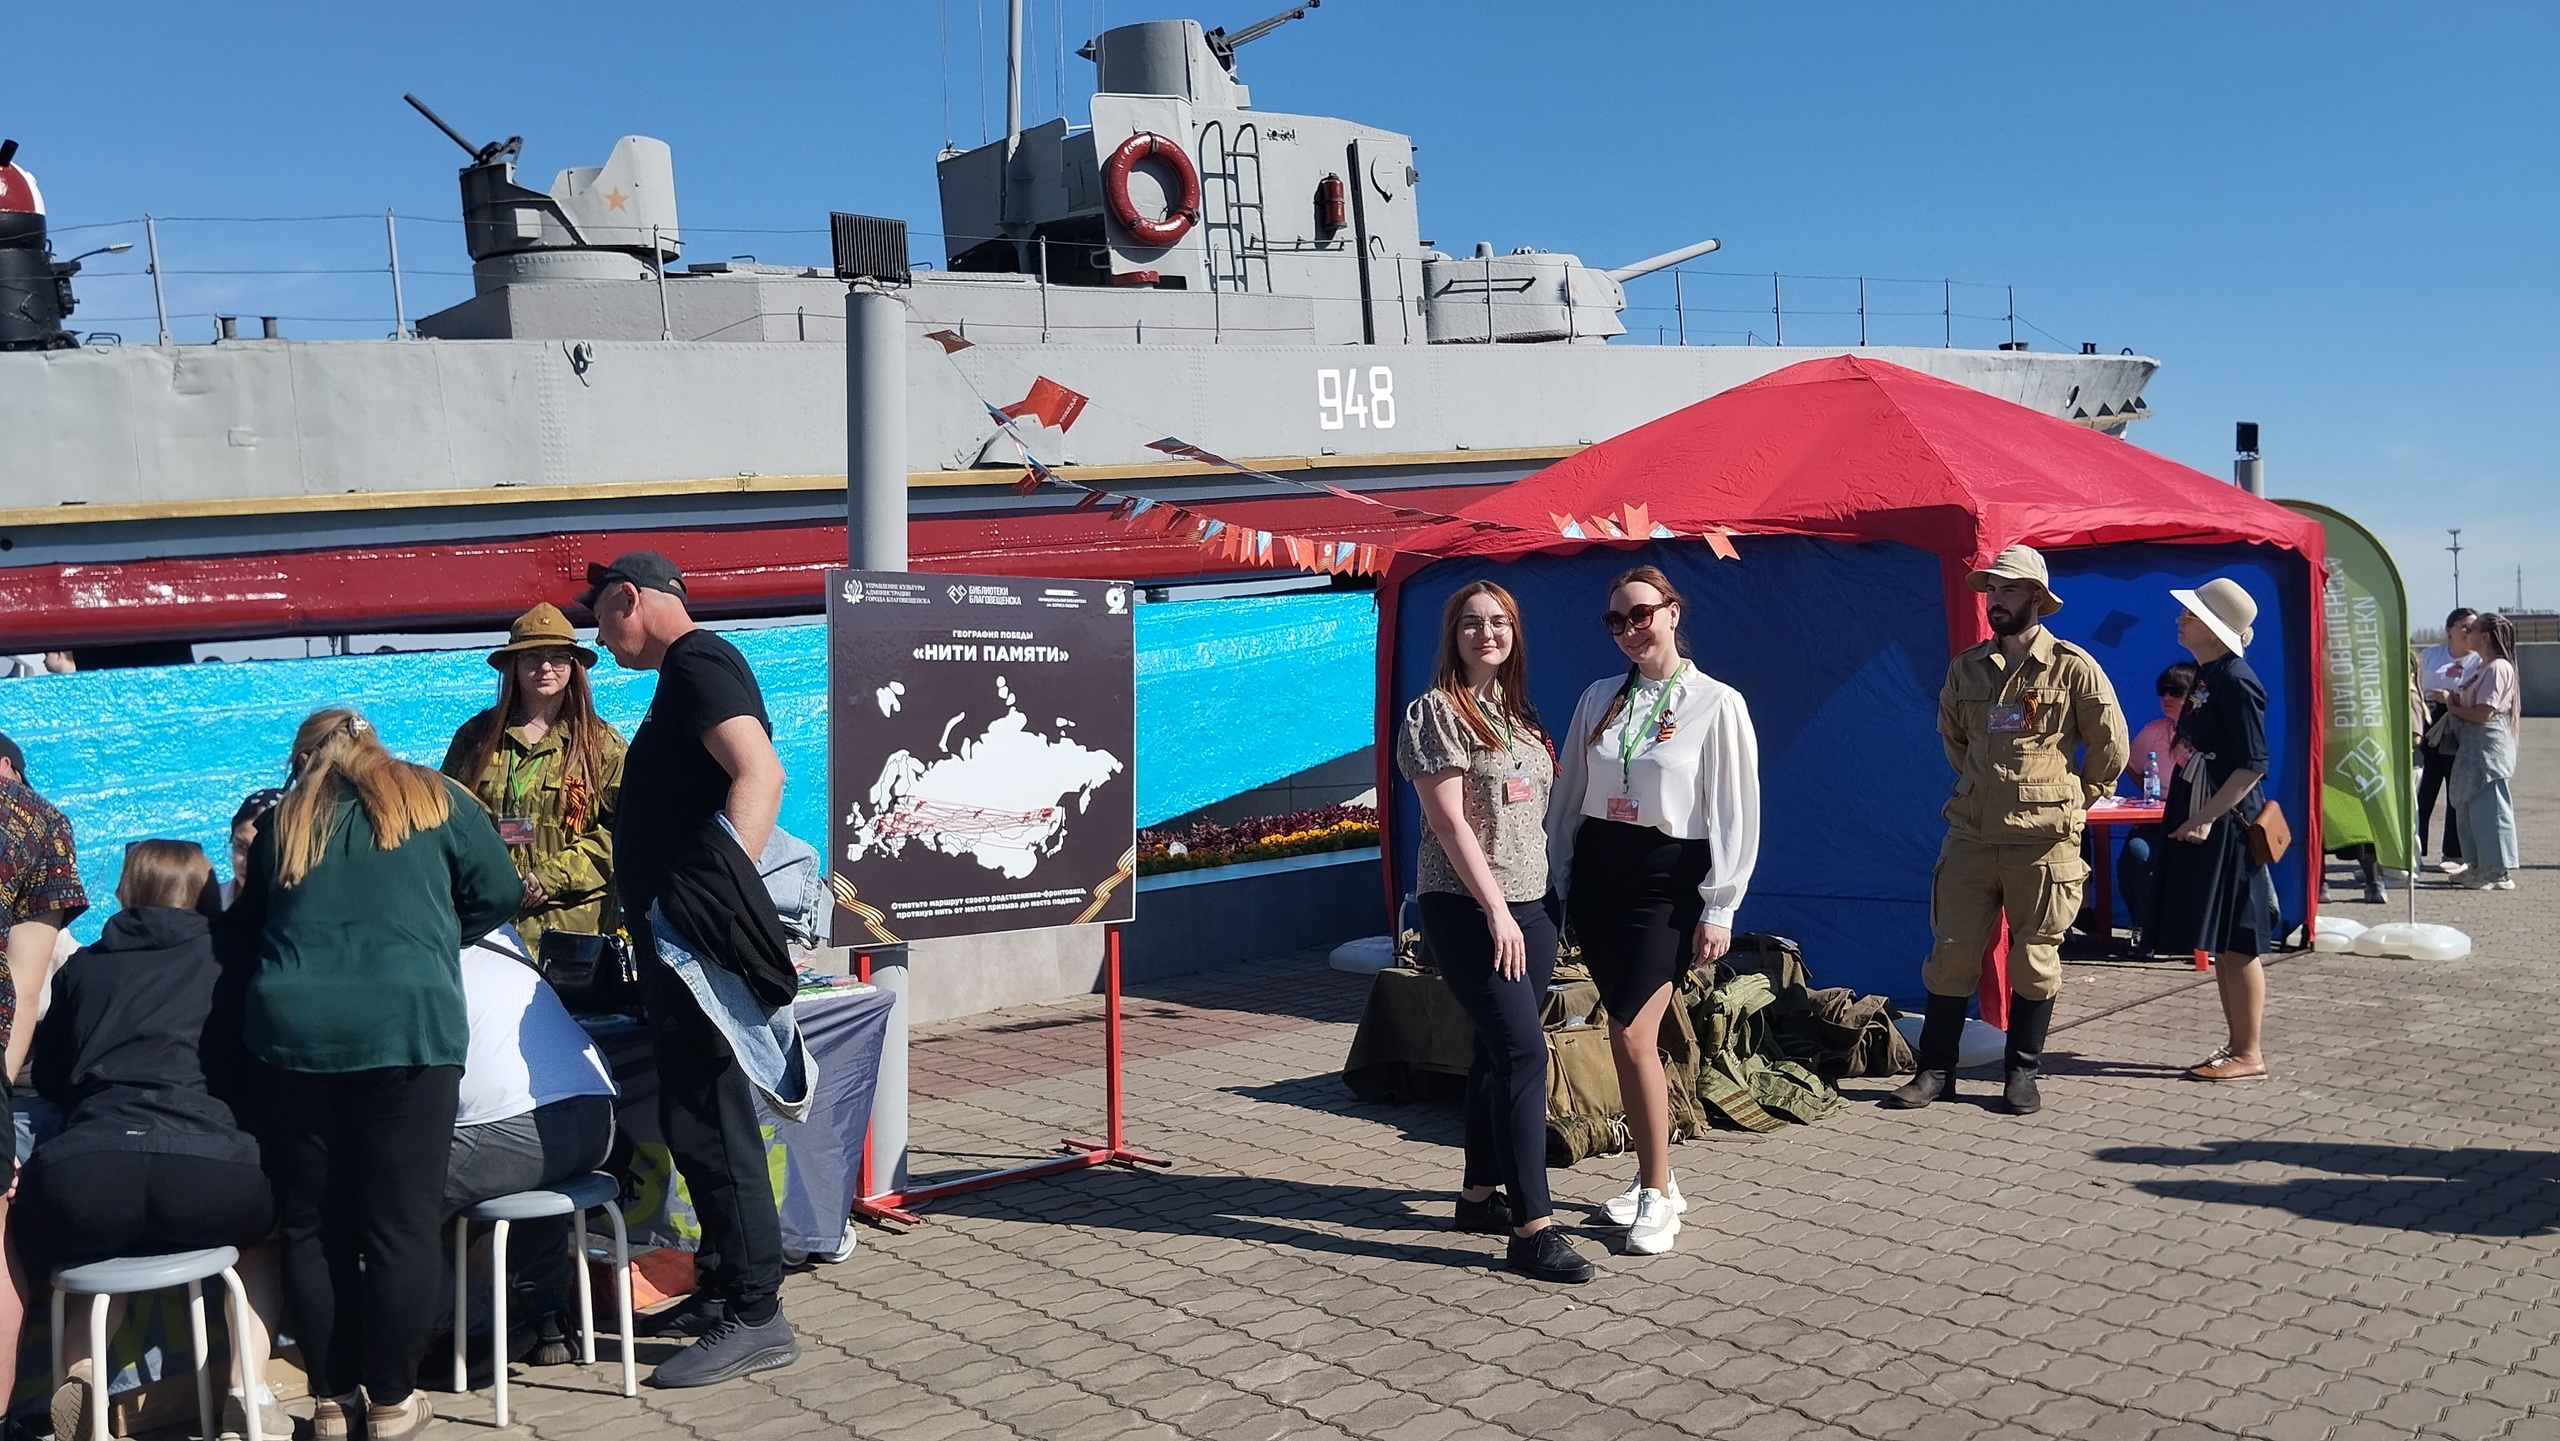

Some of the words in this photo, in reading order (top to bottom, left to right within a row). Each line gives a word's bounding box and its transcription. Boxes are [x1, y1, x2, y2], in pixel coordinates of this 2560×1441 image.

[1317, 366, 1396, 430] 948
[969, 585, 1009, 596] БИБЛИОТЕКИ
[887, 596, 931, 604] БЛАГОВЕЩЕНСКА
[969, 595, 1022, 605] БЛАГОВЕЩЕНСКА
[952, 630, 999, 639] ГЕОГРАФИЯ
[1001, 631, 1033, 640] ПОБЕДЫ
[912, 644, 977, 661] «НИТИ
[983, 645, 1070, 662] ПАМЯТИ»
[929, 898, 963, 908] маршрут
[965, 895, 990, 904] своего
[896, 909, 933, 919] протянув
[935, 908, 953, 916] нить
[987, 902, 1019, 912] призыва
[1020, 901, 1029, 909] до
